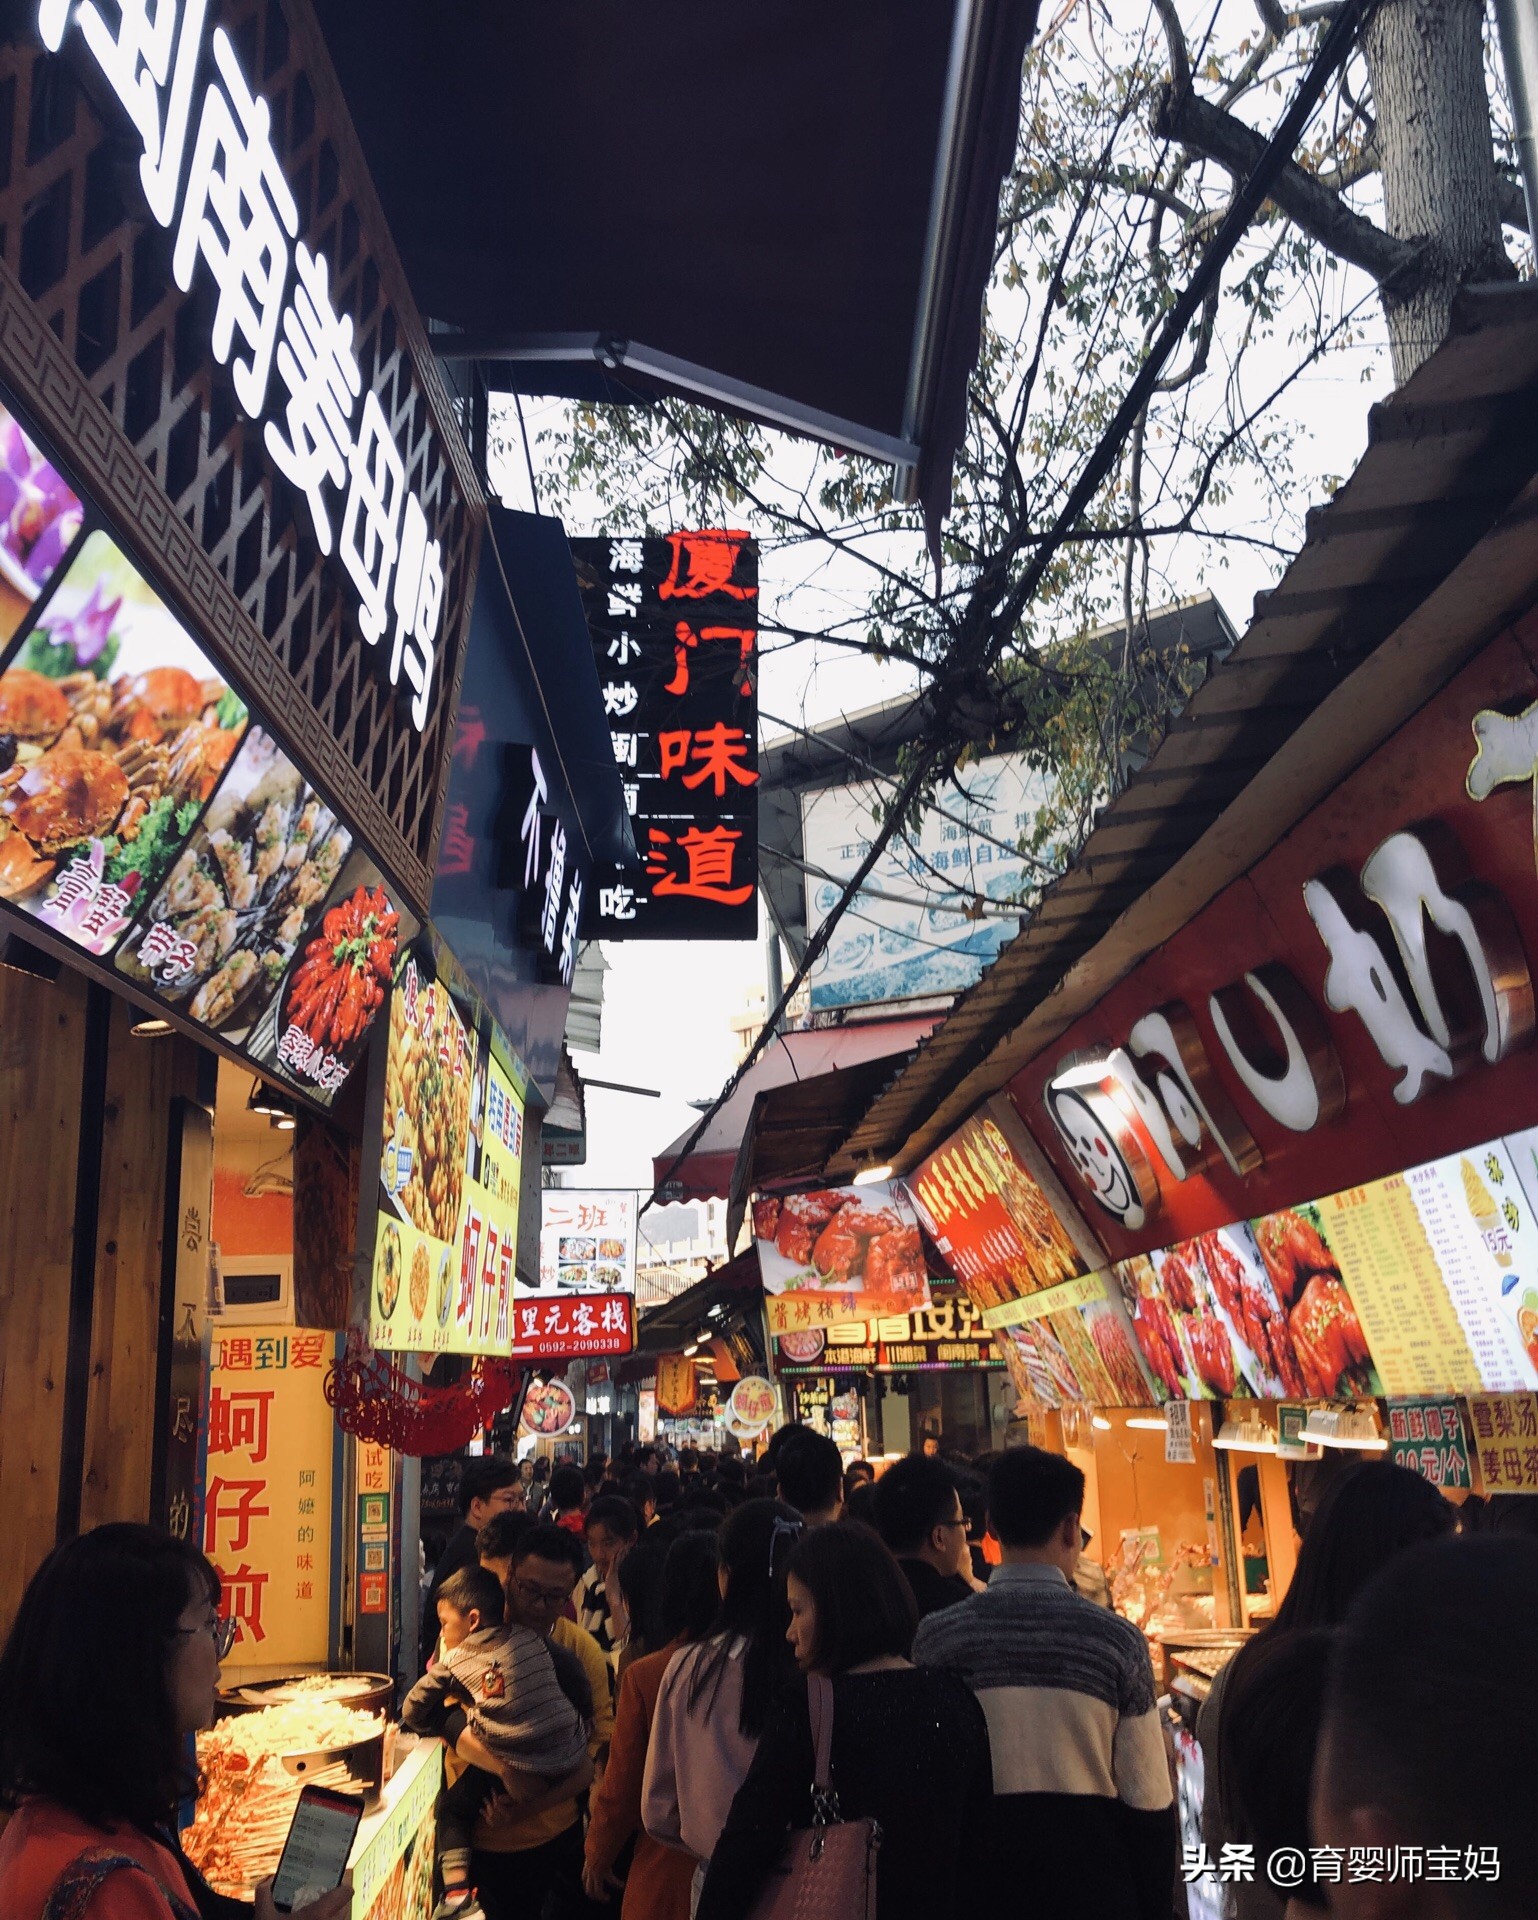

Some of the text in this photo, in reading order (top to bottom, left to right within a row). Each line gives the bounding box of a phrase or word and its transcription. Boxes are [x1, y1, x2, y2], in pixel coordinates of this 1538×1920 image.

[648, 531, 761, 905] 厦门味道
[138, 920, 198, 981] 带子
[404, 957, 465, 1079] 狼牙土豆
[1480, 1227, 1513, 1253] 15元
[457, 1197, 514, 1345] 蚵仔煎
[538, 1337, 620, 1354] 0592-2090338
[1389, 1405, 1459, 1442] 新鲜椰子
[1472, 1398, 1538, 1439] 雪梨汤
[364, 1448, 384, 1490] 试吃
[1483, 1445, 1538, 1486] 姜母茶
[203, 1387, 275, 1645] 蚵仔煎
[295, 1469, 316, 1601] 阿嬷的味道
